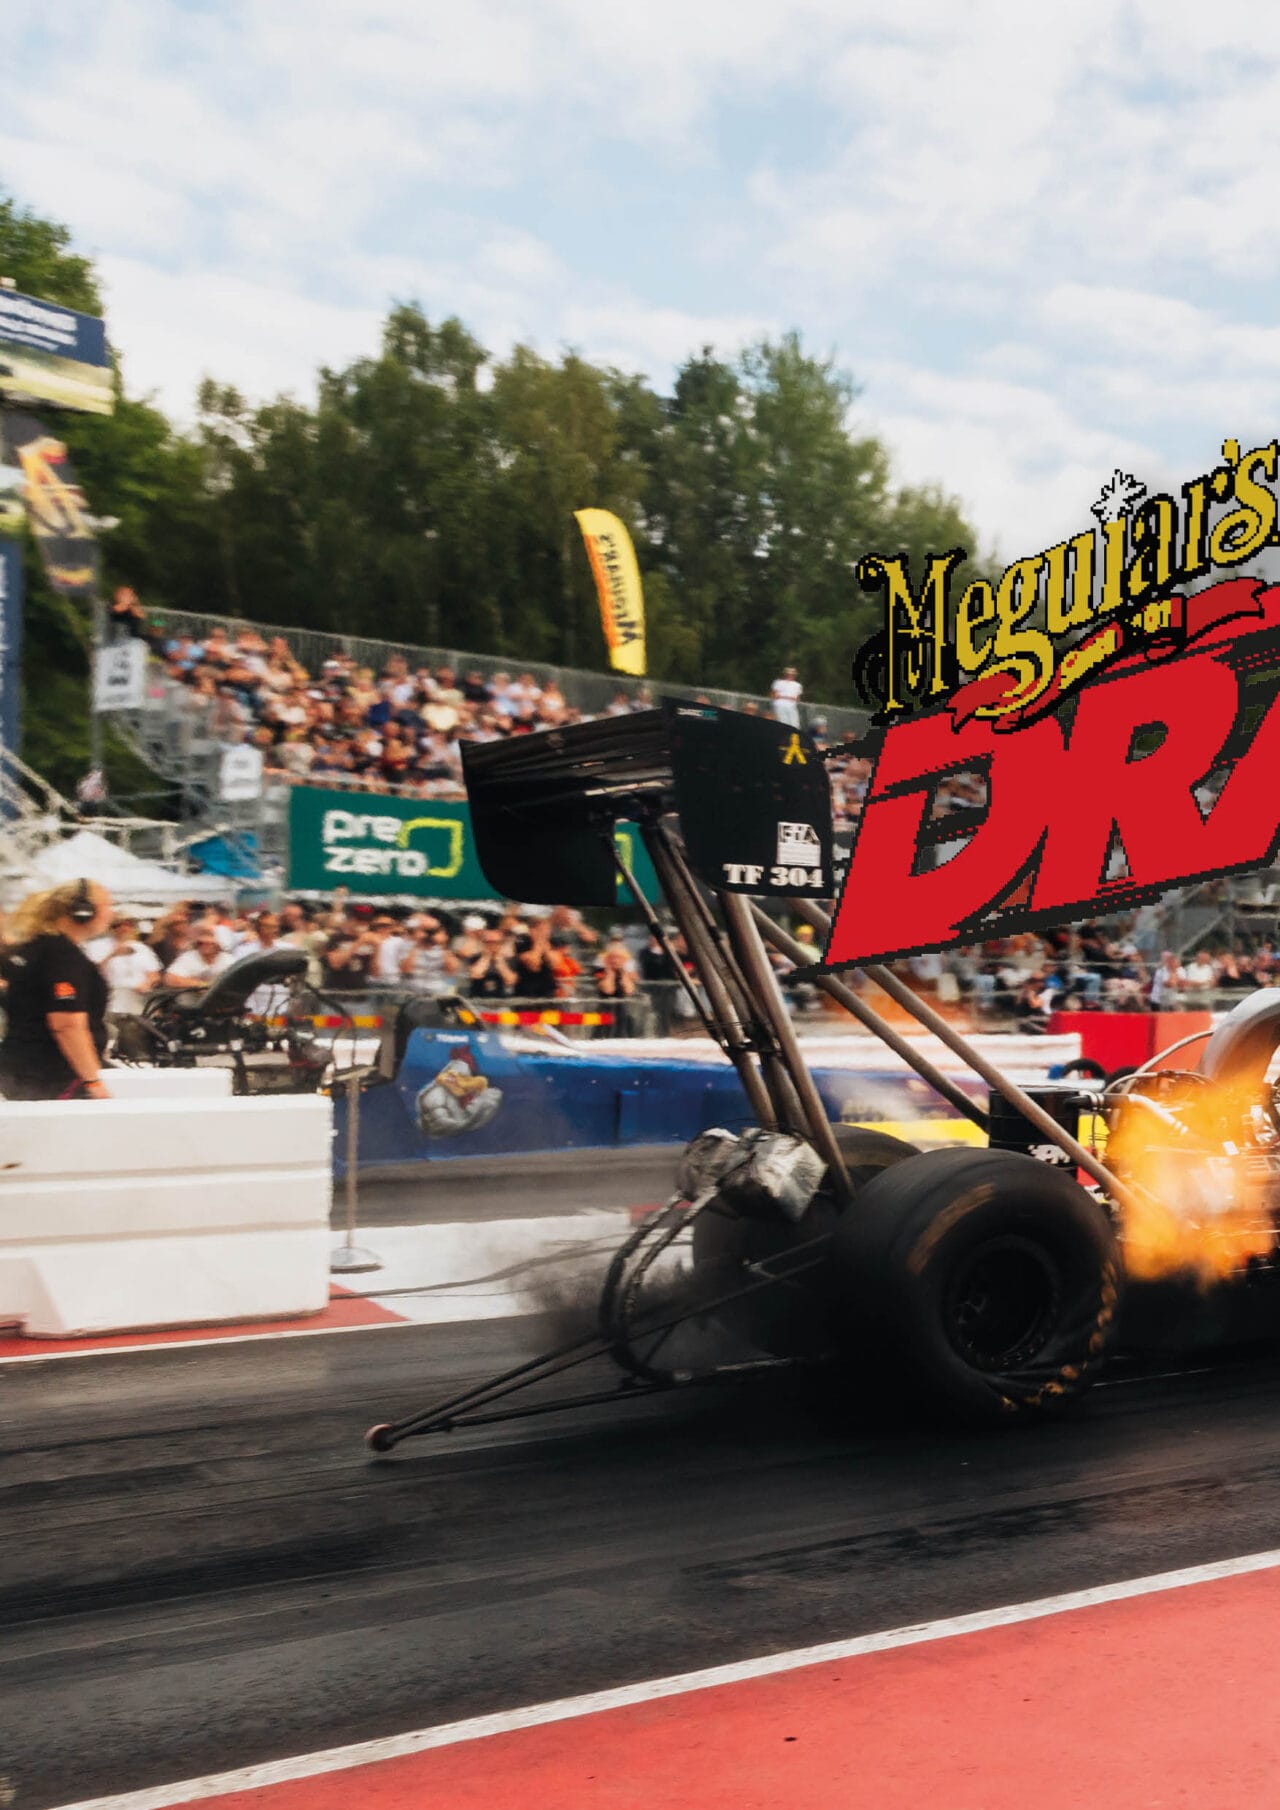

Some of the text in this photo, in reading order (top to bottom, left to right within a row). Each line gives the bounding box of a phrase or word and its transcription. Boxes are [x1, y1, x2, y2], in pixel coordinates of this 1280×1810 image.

[322, 810, 402, 844] pre
[323, 847, 430, 877] zero
[722, 863, 825, 888] TF 304
